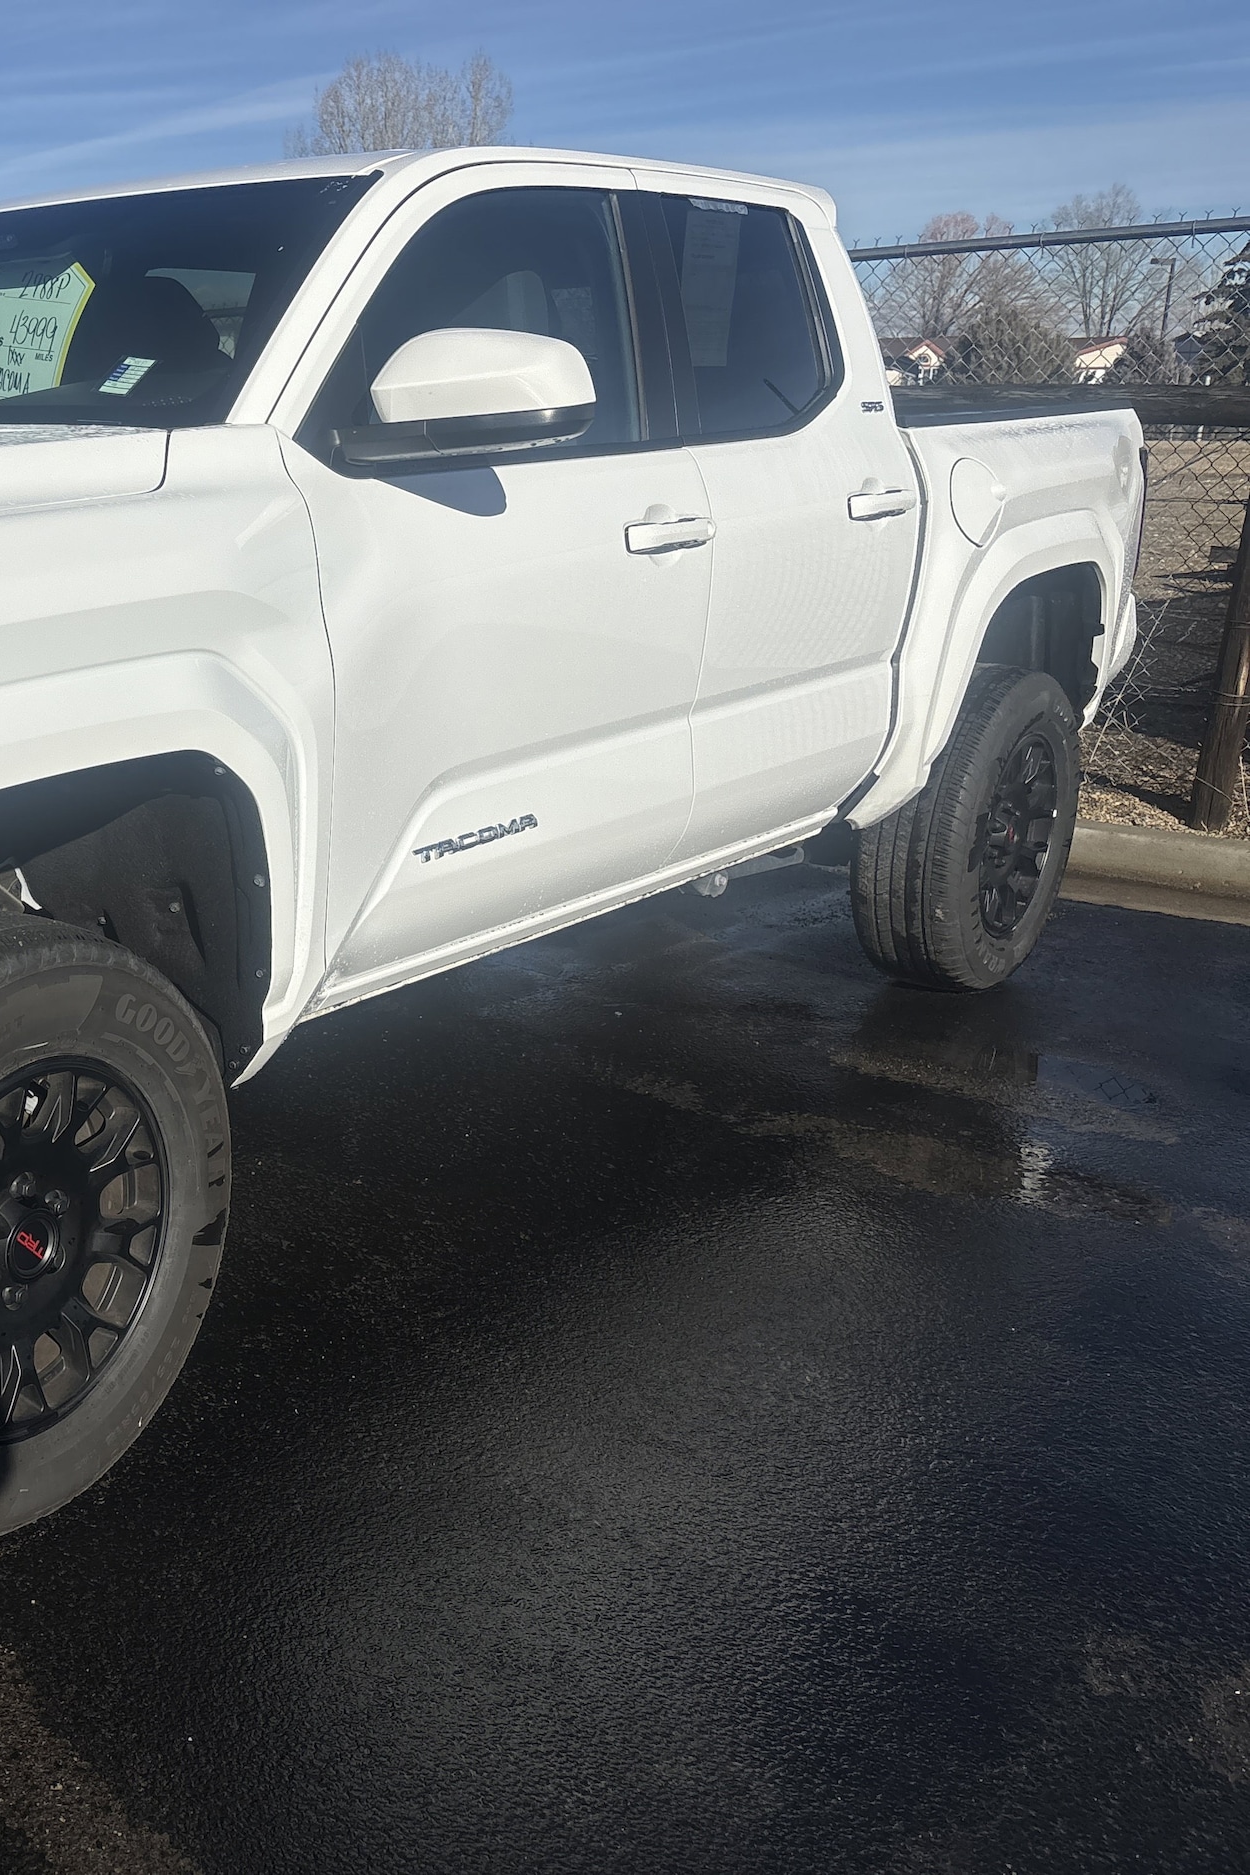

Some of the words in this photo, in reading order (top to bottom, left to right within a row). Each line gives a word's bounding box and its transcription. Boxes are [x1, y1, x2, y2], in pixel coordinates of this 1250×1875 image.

[10, 309, 58, 356] 43999
[35, 352, 54, 362] MILES
[412, 813, 538, 863] TACOMA
[115, 993, 226, 1189] GOODYEAR
[16, 1231, 44, 1260] TRD
